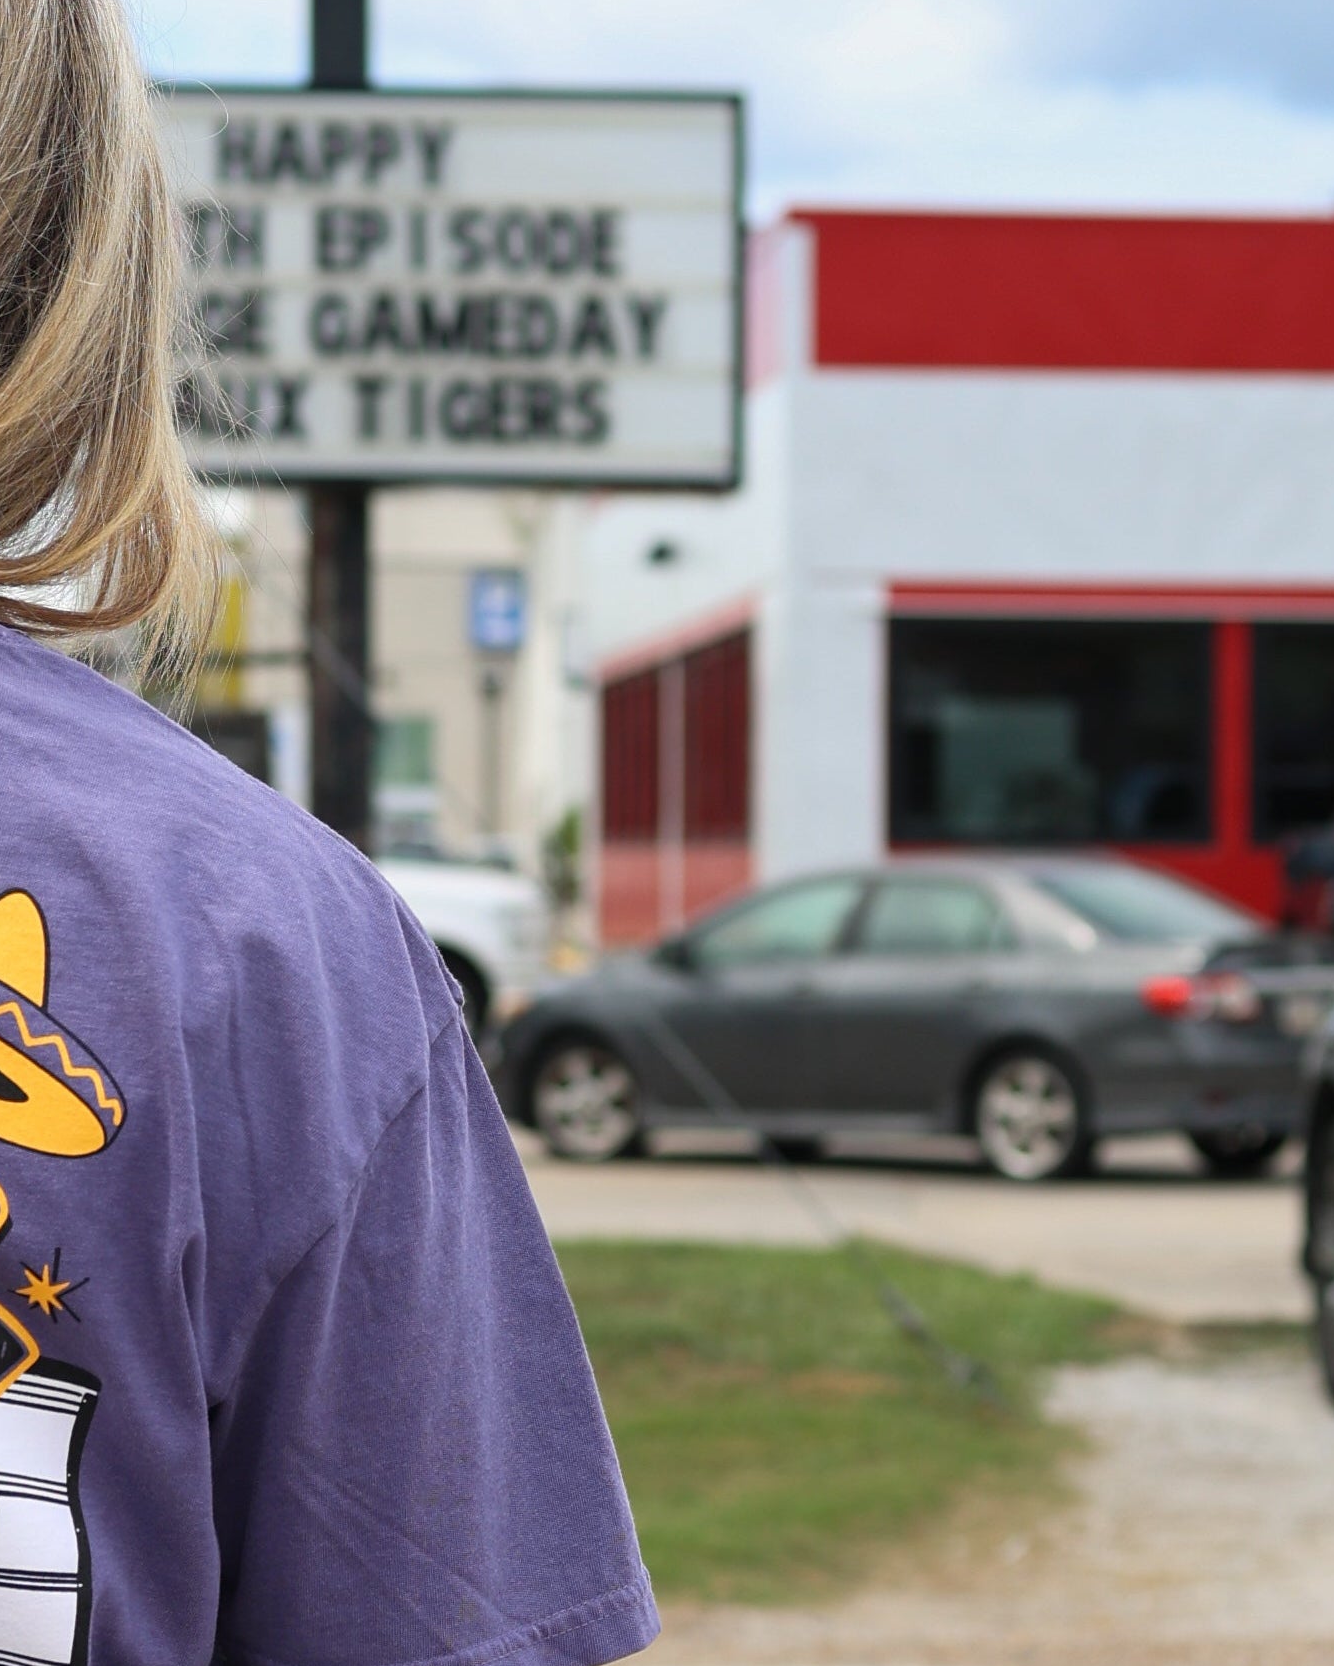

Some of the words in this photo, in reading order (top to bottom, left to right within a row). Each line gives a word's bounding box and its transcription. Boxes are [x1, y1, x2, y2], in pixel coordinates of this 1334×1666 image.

[217, 118, 451, 185] HAPPY
[317, 204, 618, 276] EPISODE
[310, 288, 667, 361] GAMEDAY
[353, 375, 609, 445] TIGERS
